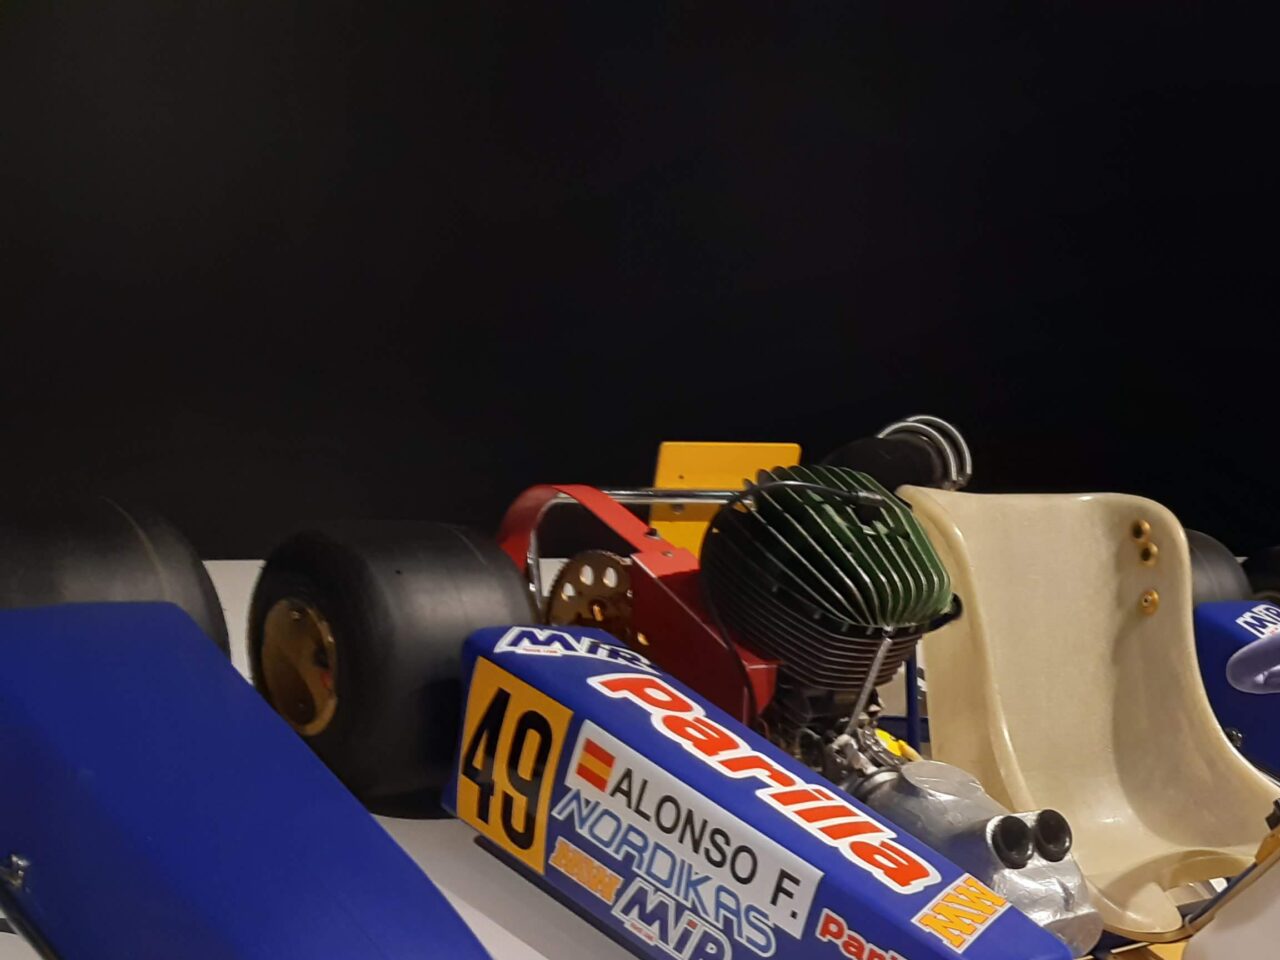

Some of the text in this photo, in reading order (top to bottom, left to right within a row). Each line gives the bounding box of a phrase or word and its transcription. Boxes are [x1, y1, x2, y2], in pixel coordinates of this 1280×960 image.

[461, 685, 552, 850] 49
[594, 675, 936, 891] Parilla
[609, 766, 802, 920] ALONSO F.
[551, 788, 776, 957] NORDIKAS
[915, 875, 1011, 952] MW
